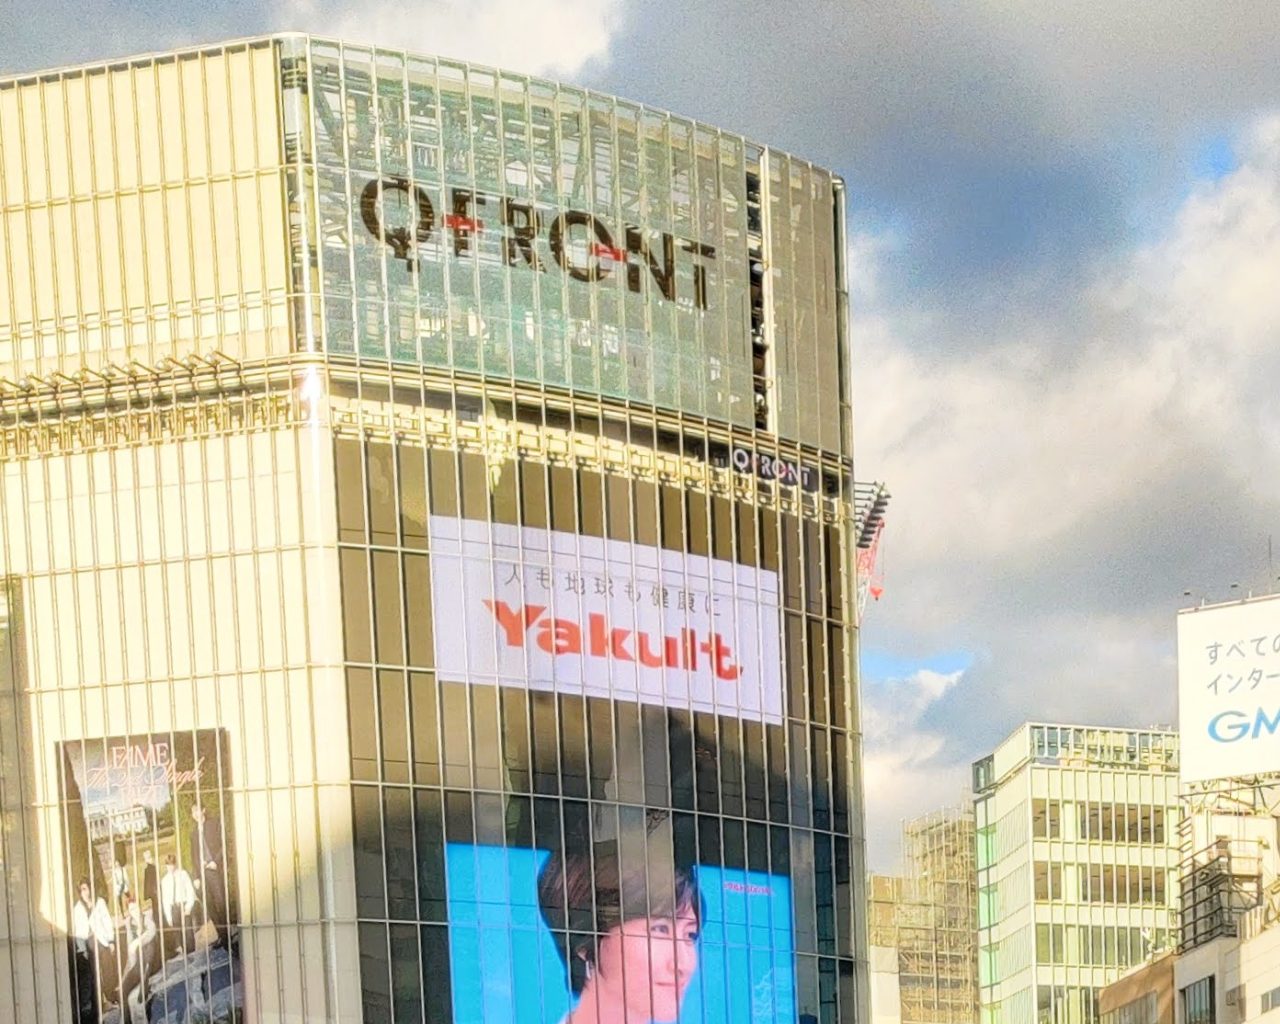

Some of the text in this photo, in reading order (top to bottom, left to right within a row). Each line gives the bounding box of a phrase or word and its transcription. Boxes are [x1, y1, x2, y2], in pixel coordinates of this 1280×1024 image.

[361, 177, 716, 310] QFRONT
[733, 449, 810, 486] QFRONT
[504, 564, 721, 617] 人も地球も健康に
[482, 599, 743, 680] Yakult
